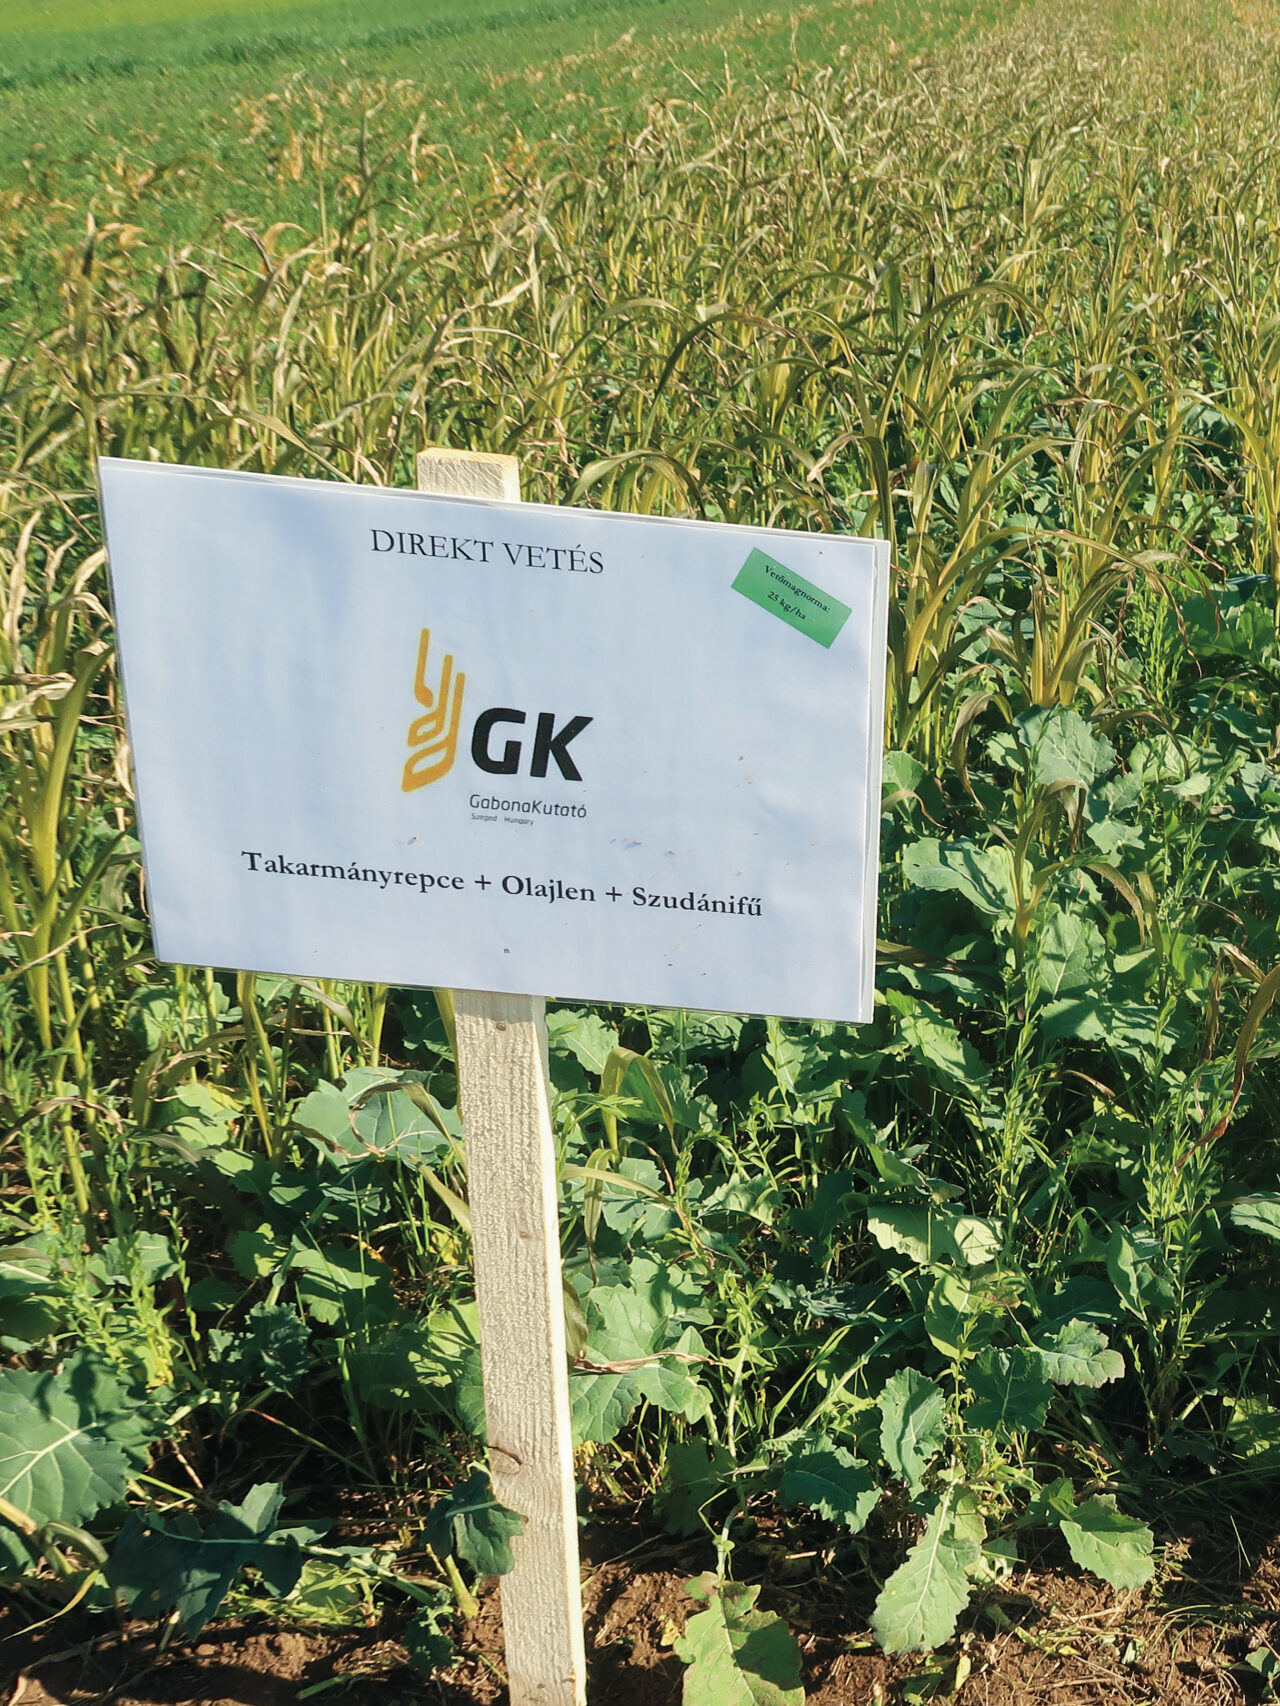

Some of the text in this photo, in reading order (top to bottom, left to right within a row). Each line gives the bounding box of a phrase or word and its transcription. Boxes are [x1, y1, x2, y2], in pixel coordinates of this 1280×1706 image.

[370, 529, 604, 574] DIREKT VETÉS
[764, 564, 831, 613] Vetőmagnorma:
[767, 591, 807, 620] 25 kg/ha
[471, 707, 594, 782] GK
[469, 794, 588, 819] GabonaKutató
[241, 851, 763, 917] Takarmányrepce + Olajlen + Szudánifű
